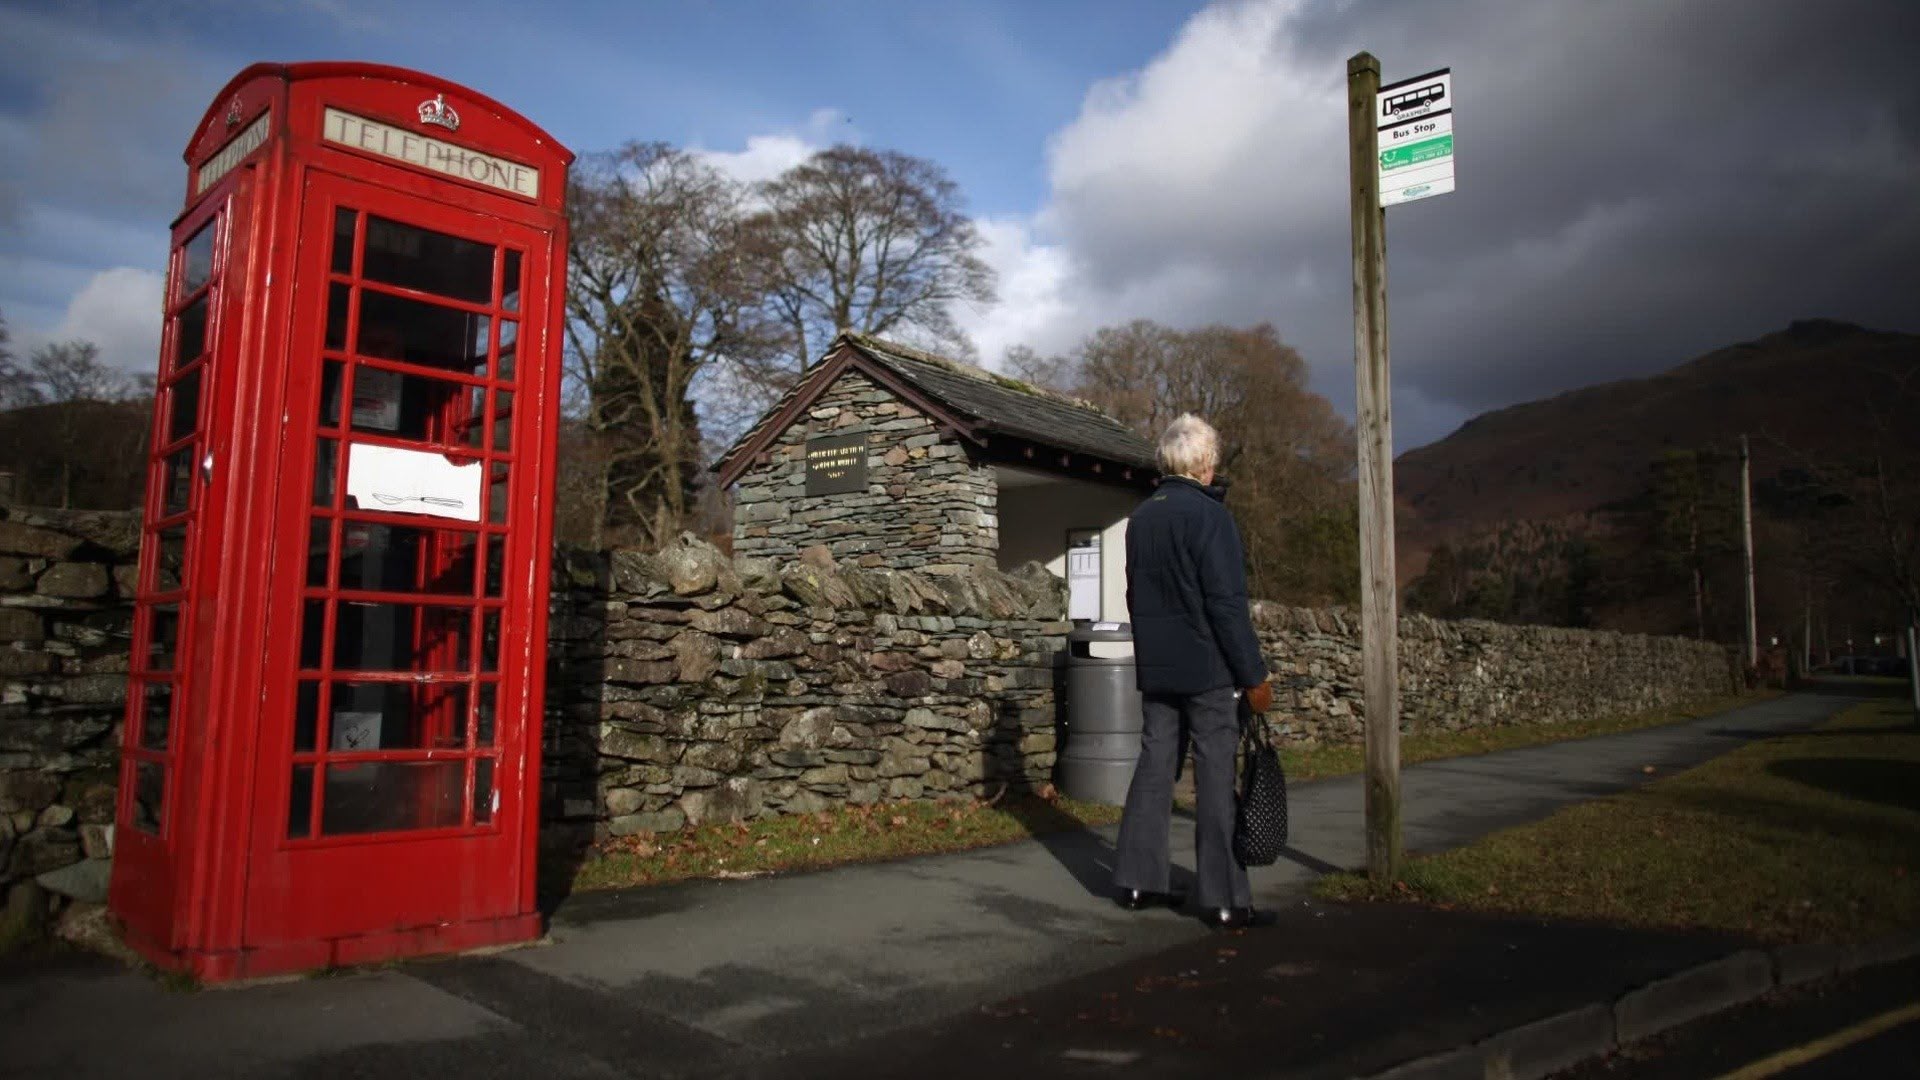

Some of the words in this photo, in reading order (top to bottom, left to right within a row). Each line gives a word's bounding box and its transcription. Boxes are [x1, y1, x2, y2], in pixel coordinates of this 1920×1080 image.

[333, 114, 529, 193] TELEPHONE
[1392, 130, 1410, 139] Bus
[1414, 123, 1436, 134] Stop
